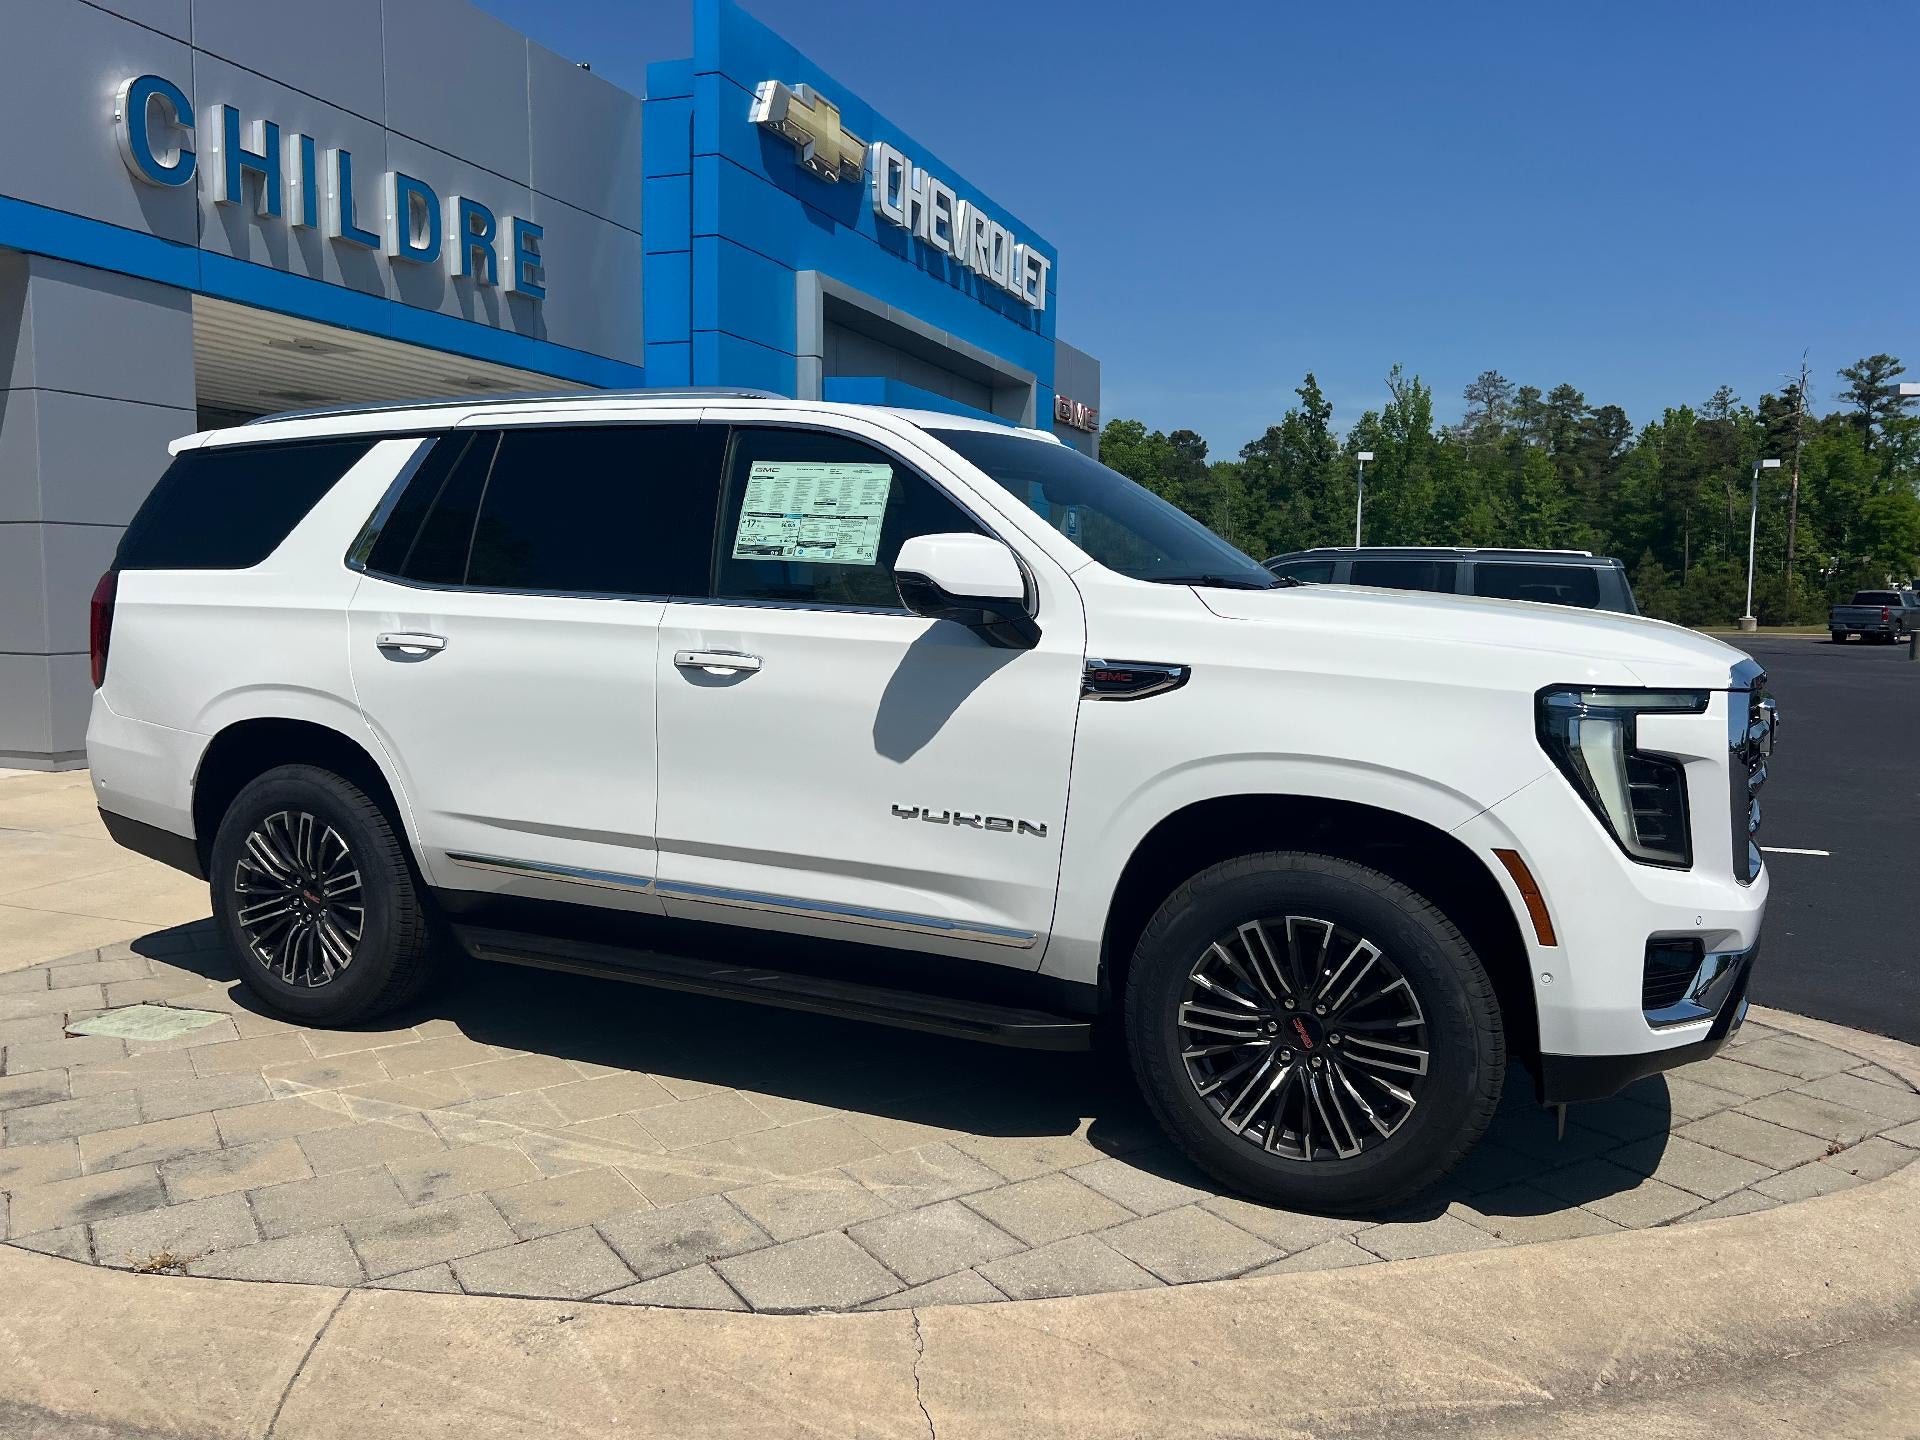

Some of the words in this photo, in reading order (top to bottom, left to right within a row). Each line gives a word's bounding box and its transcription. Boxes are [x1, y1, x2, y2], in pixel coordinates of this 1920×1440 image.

[115, 74, 547, 301] CHILDRE
[870, 141, 1051, 312] CHEVROLET
[1095, 671, 1133, 682] GMC
[891, 803, 1047, 838] YUKON
